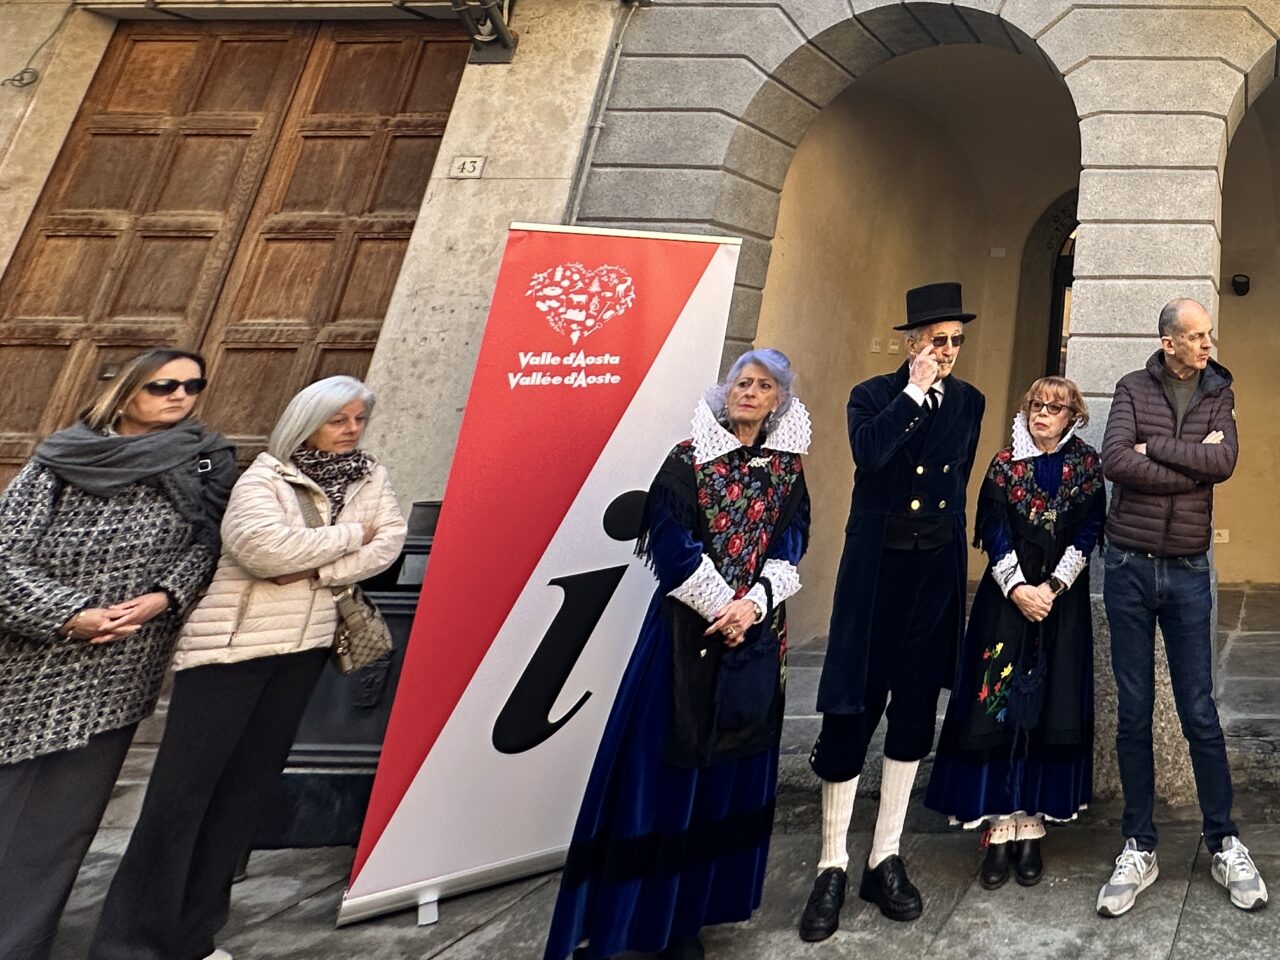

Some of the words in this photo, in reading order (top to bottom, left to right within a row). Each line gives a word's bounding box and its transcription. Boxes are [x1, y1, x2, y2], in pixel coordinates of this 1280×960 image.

[457, 160, 477, 173] 43
[518, 351, 561, 369] Valle
[562, 349, 620, 367] d'Aosta
[508, 372, 562, 390] Vallée
[564, 369, 621, 388] d'Aoste
